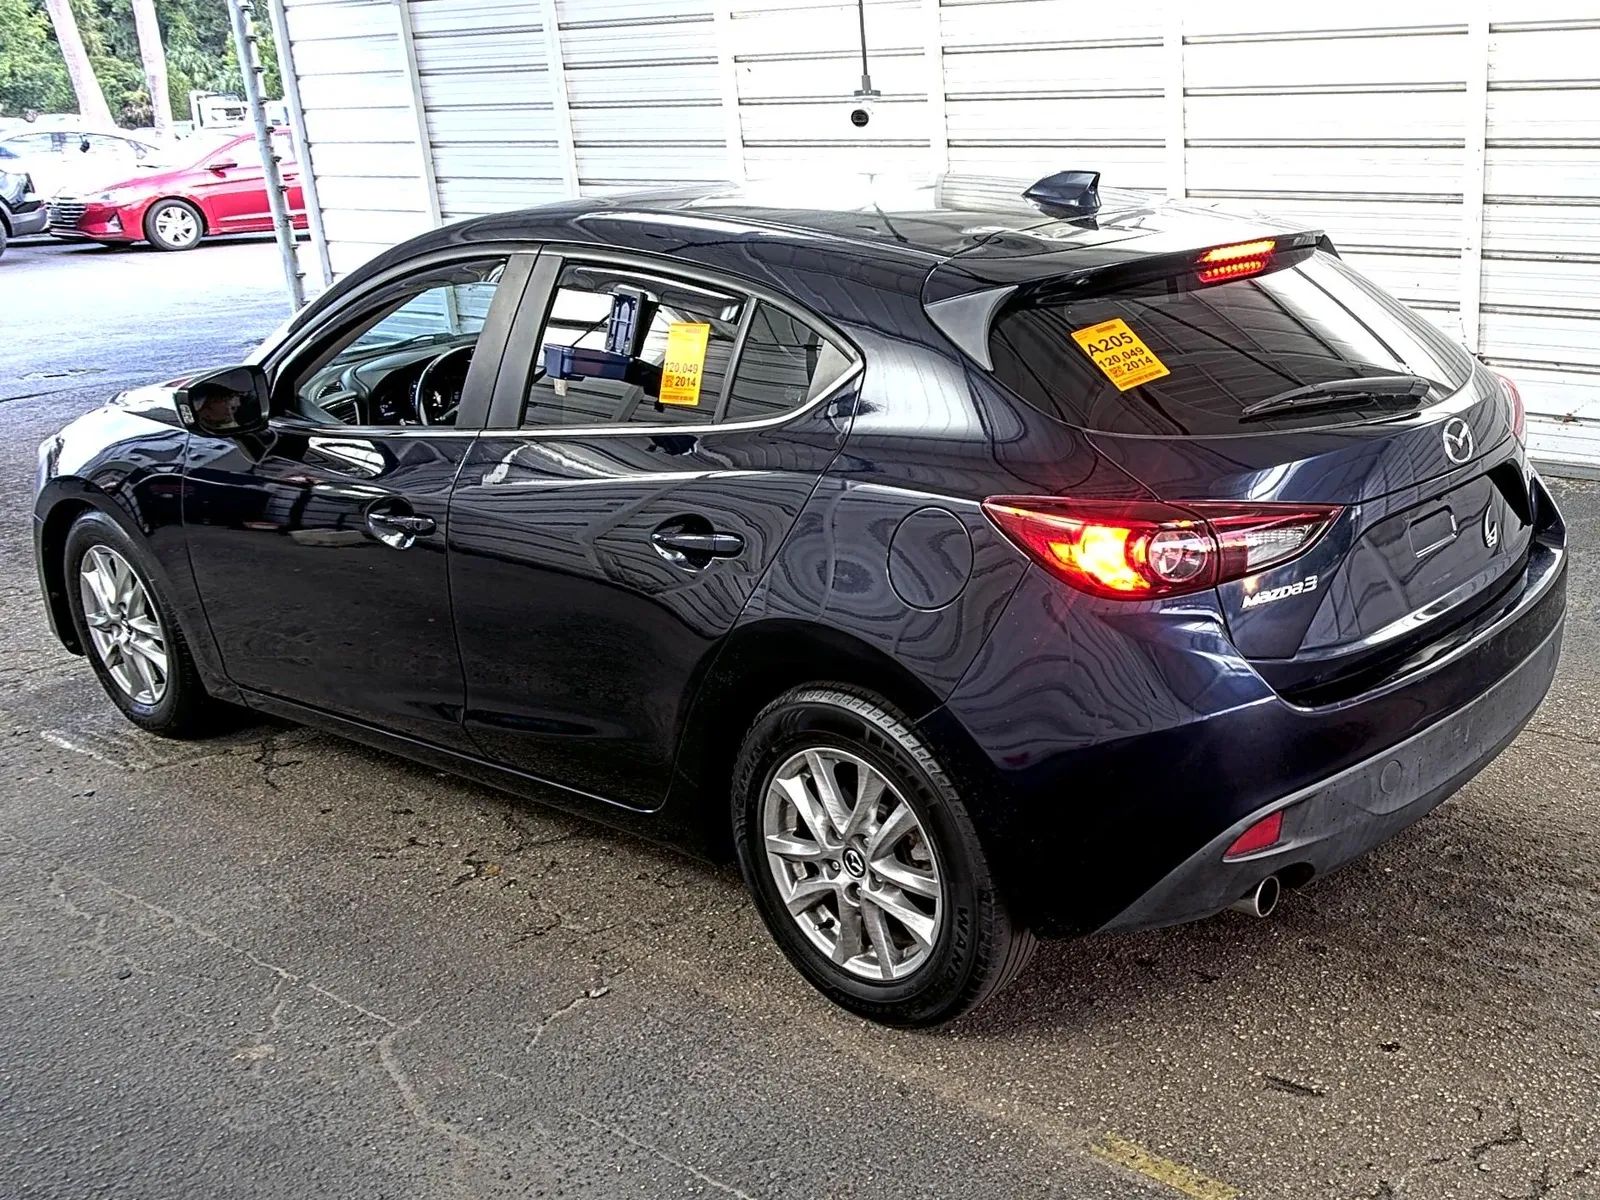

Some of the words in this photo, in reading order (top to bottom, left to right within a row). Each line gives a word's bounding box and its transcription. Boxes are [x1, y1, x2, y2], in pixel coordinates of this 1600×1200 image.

[1087, 332, 1134, 356] A205
[1098, 346, 1145, 368] 120,049
[1122, 356, 1153, 371] 2014
[665, 362, 698, 374] 120,049
[675, 376, 696, 387] 2014
